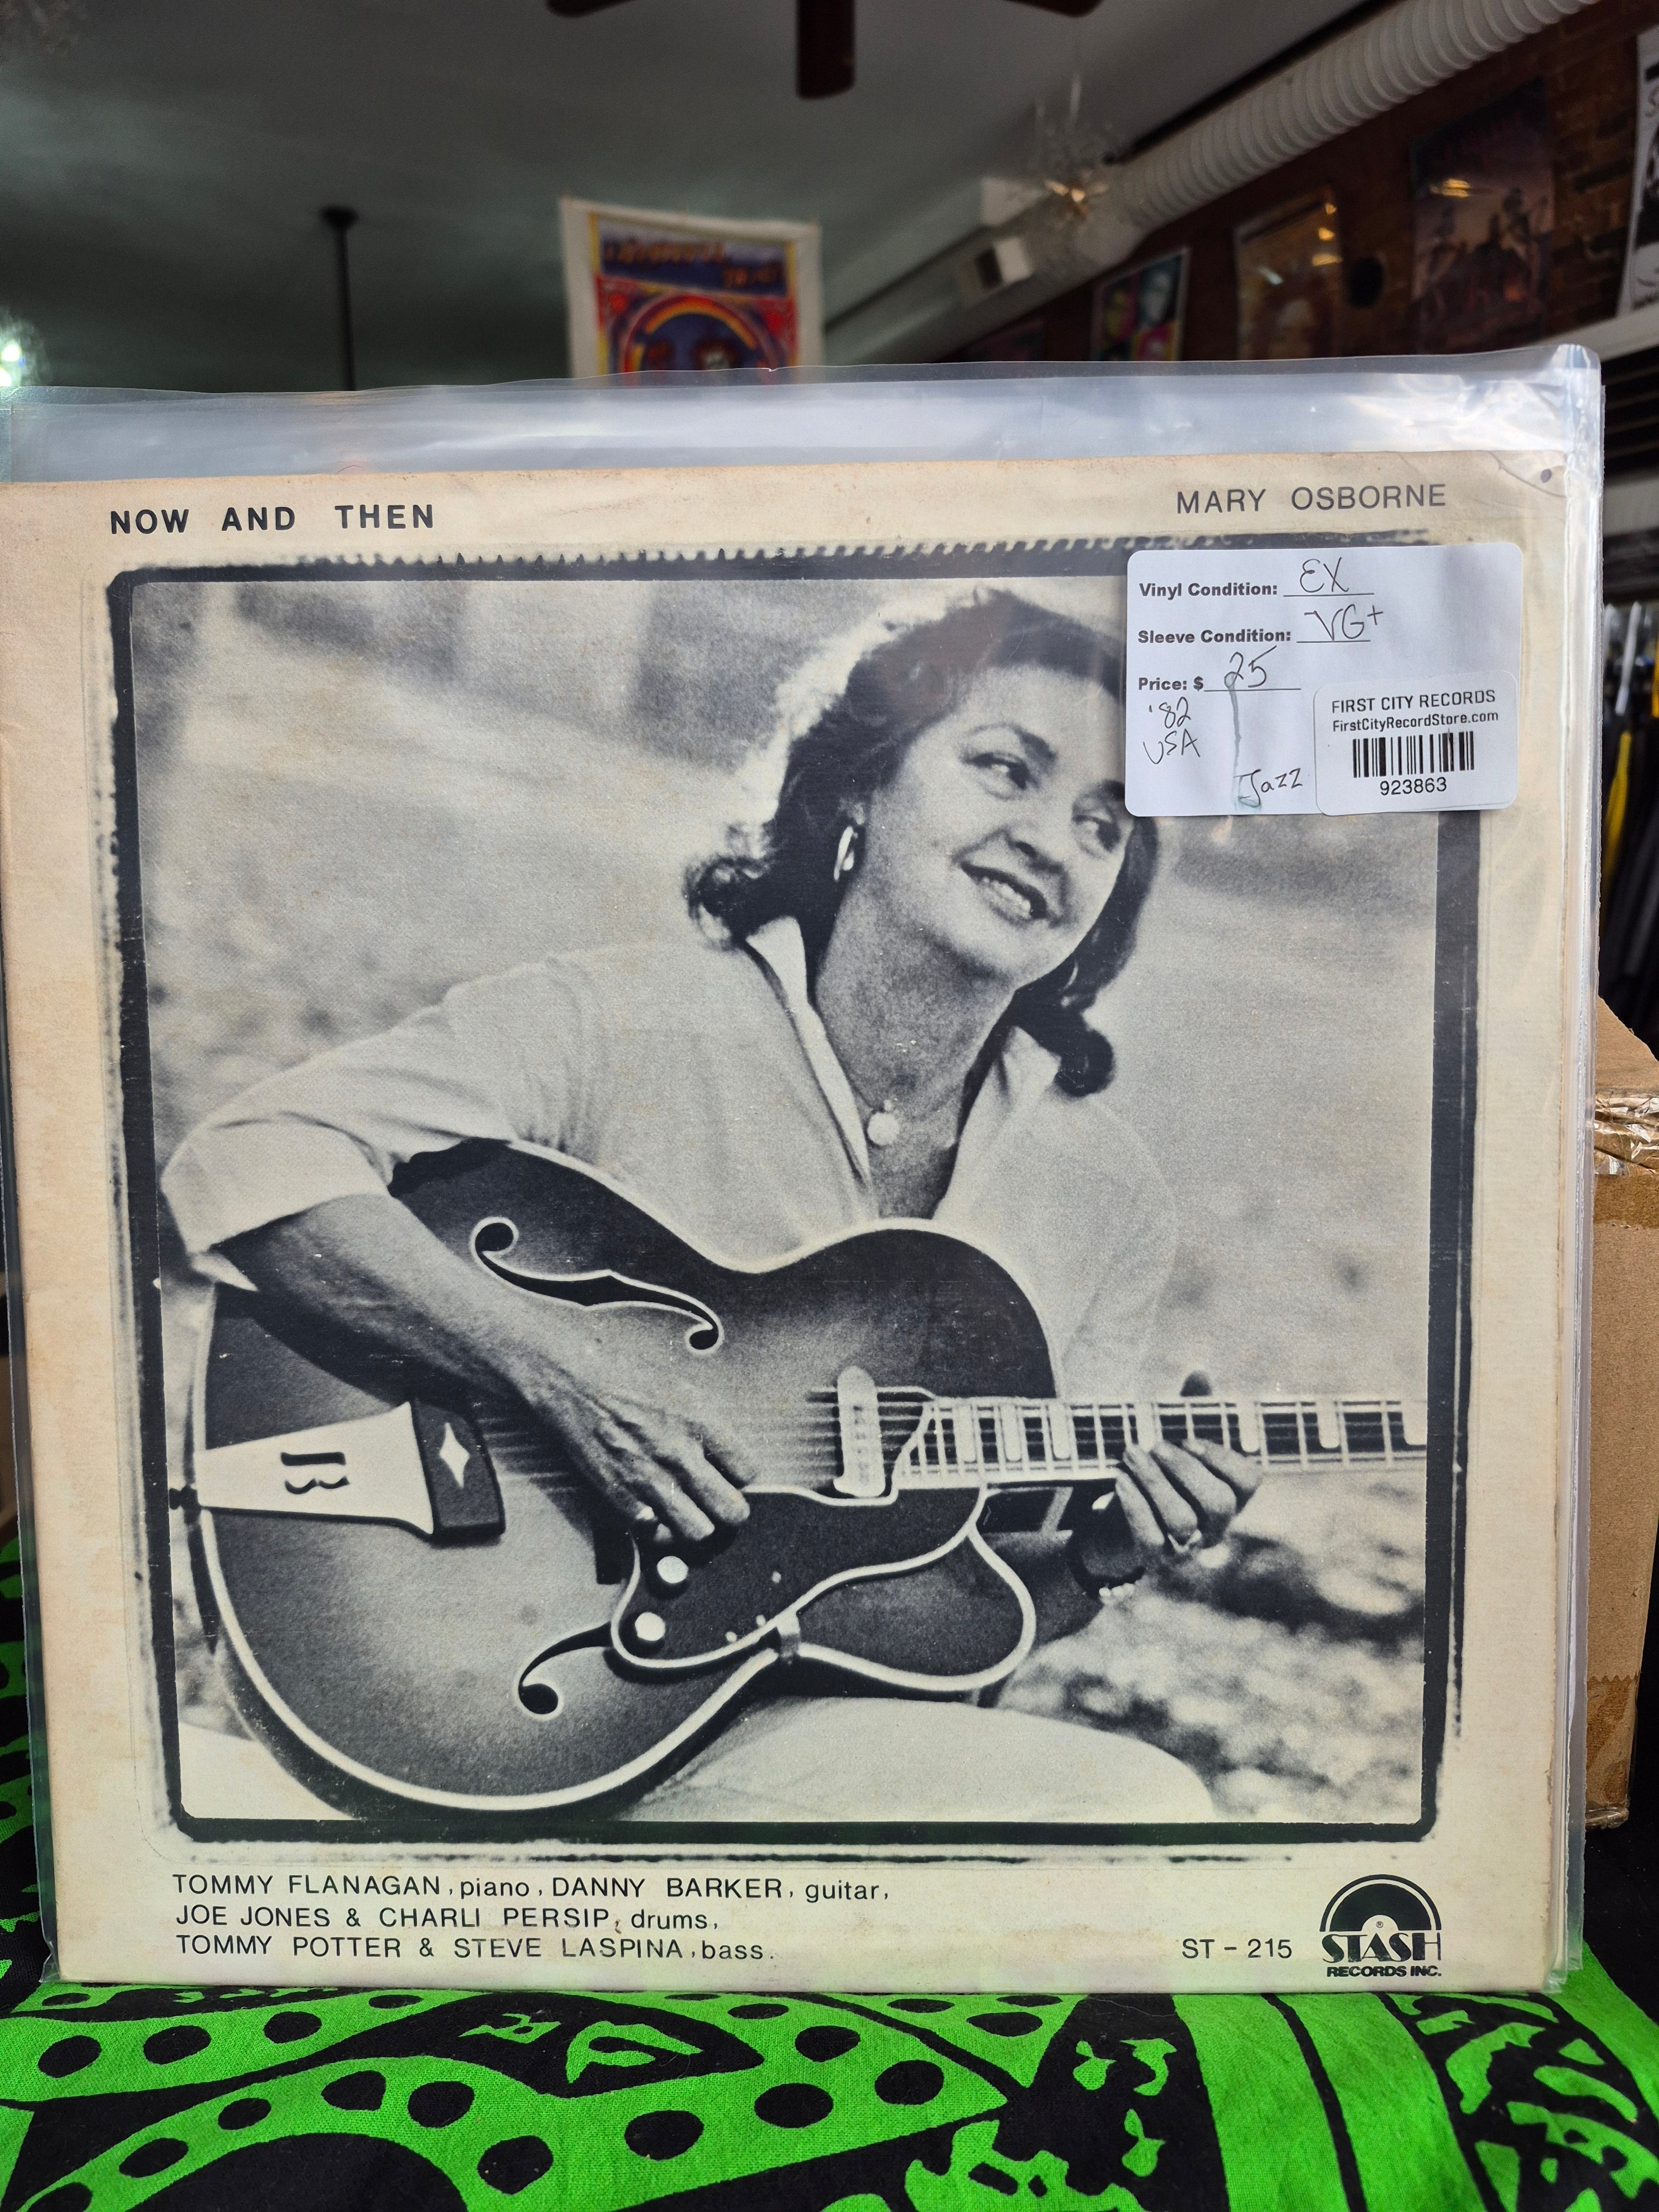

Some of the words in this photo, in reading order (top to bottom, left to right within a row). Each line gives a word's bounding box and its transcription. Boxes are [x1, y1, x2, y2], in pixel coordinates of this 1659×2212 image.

[1176, 489, 1267, 514] MARY
[1291, 484, 1446, 511] OSBORNE
[111, 509, 189, 534] NOW
[221, 507, 295, 531] AND
[335, 504, 434, 529] THEN
[1139, 582, 1182, 597] Vinyl
[1188, 582, 1278, 597] Condition:
[1300, 557, 1349, 594] EX
[1138, 629, 1195, 644] Sleeve
[1200, 629, 1291, 643] Condition:
[1304, 604, 1384, 640] VG+
[1138, 677, 1188, 691] Price:
[1193, 676, 1204, 692] $
[1224, 646, 1277, 690] 25
[1332, 698, 1376, 714] FIRST
[1381, 695, 1413, 711] CITY
[1420, 690, 1496, 708] RECORDS
[1332, 711, 1499, 733] FirstCityRecordStore.com
[1143, 729, 1200, 765] USA
[1379, 776, 1448, 796] 923863
[172, 1874, 273, 1895] TOMMY
[552, 1877, 646, 1897] DANNY
[805, 1880, 889, 1903] guitar,
[176, 1904, 227, 1926] JOE
[240, 1906, 330, 1927] JONES
[346, 1907, 362, 1927] &
[379, 1907, 481, 1928] CHARLI
[630, 1908, 718, 1931] drums,
[176, 1935, 273, 1954] TOMMY
[293, 1937, 400, 1957] POTTER
[419, 1938, 435, 1957] &
[453, 1937, 541, 1958] STEVE
[702, 1940, 775, 1960] bass.
[1321, 1932, 1442, 1963] STASH
[1327, 1965, 1407, 1977] RECORDS
[1410, 1965, 1442, 1976] INC.
